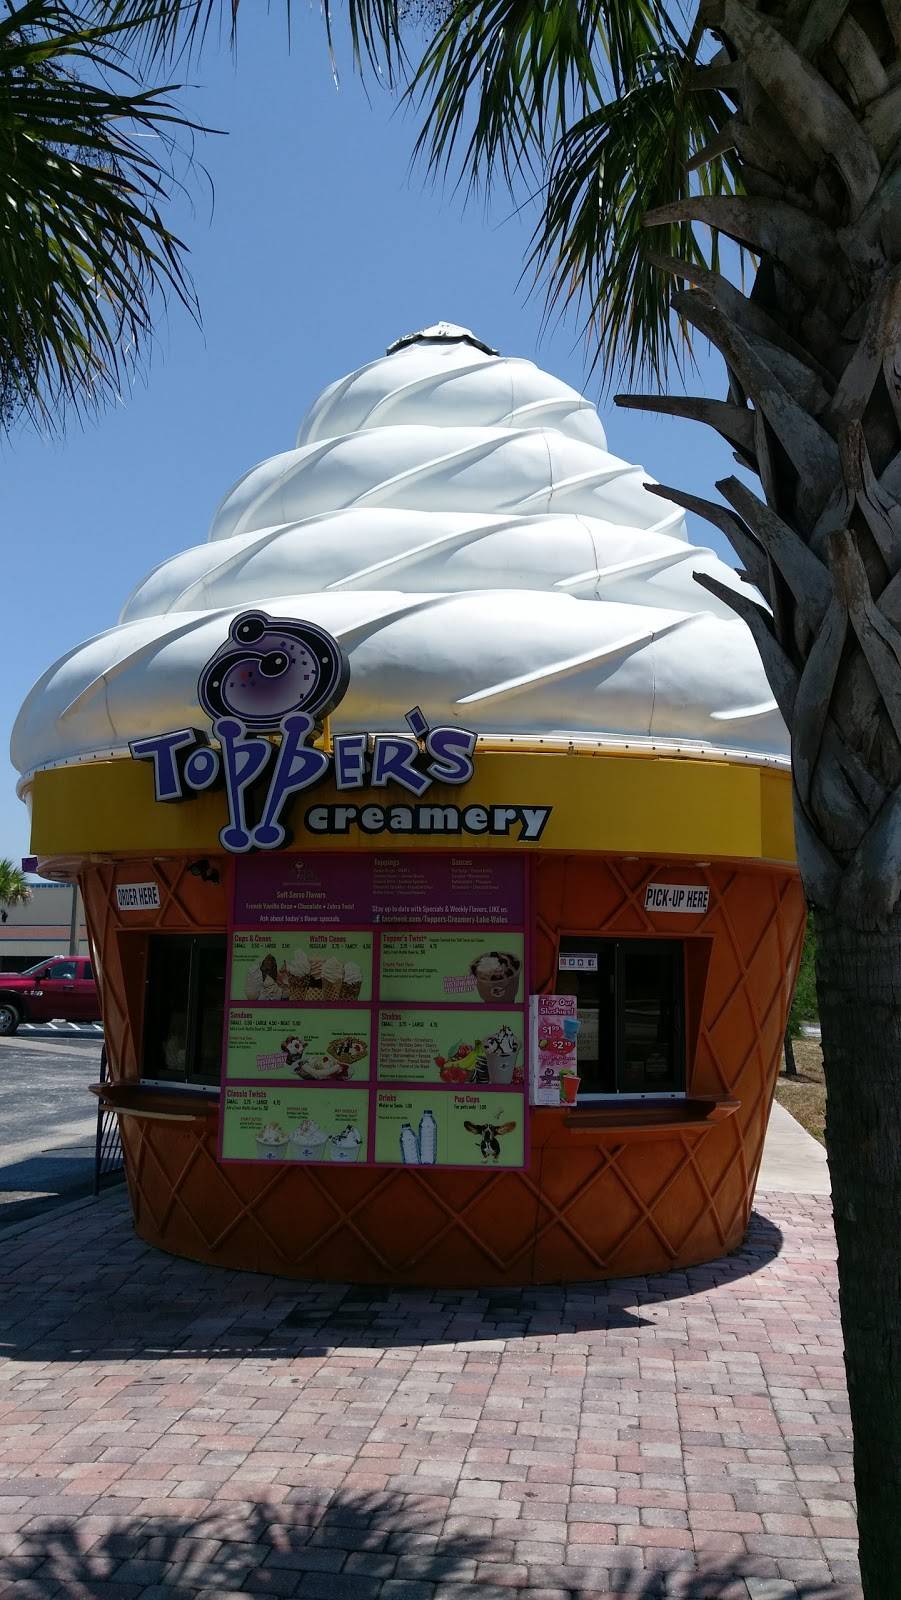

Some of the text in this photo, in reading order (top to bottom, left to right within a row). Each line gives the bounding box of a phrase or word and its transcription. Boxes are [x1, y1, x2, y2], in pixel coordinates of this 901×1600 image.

[305, 803, 553, 842] creamery
[117, 886, 158, 906] ORDER HERE
[646, 888, 709, 908] PICK-UP HERE
[541, 998, 574, 1007] Try Our
